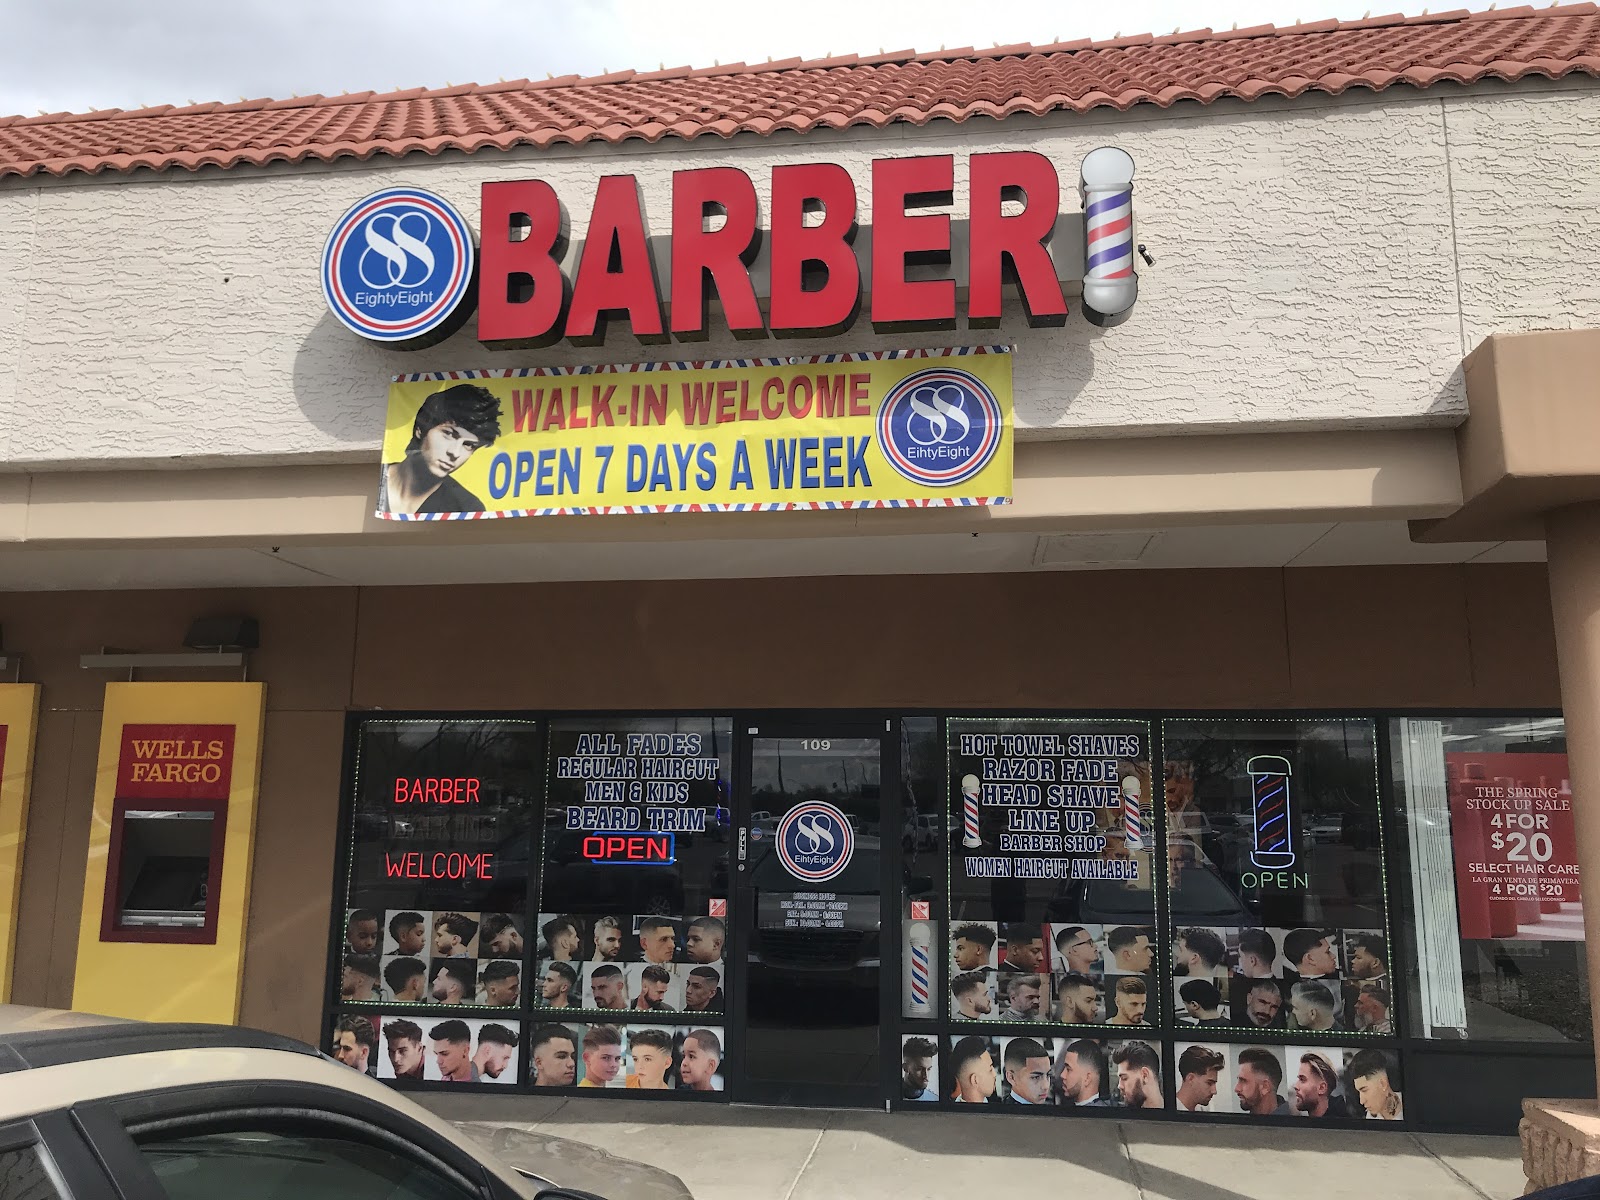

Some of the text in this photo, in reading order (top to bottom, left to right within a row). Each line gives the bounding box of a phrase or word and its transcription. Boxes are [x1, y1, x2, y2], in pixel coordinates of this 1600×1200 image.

[477, 150, 1068, 342] BARBER
[355, 290, 434, 310] EightyEight
[511, 373, 872, 433] WALK-IN WELCOME
[907, 445, 970, 461] EihtyEight
[488, 435, 873, 499] OPEN 7 DAYS A WEEK
[131, 739, 224, 760] WELLS
[576, 733, 702, 756] ALL FADES
[800, 739, 831, 750] 109
[960, 734, 1139, 757] HOT TOWEL SHAVES
[130, 763, 222, 783] FARGO
[557, 757, 719, 780] REGULAR HAIRCUT
[983, 758, 1118, 782] RAZOR FADE
[394, 777, 480, 803] BARBER
[585, 781, 689, 803] MEN & KIDS
[982, 784, 1120, 808] HEAD SHAVE
[1475, 786, 1559, 799] THE SPRING
[1466, 799, 1571, 811] STOCK UP SALE
[566, 806, 706, 831] BEARD TRIM
[1008, 810, 1096, 833] LINE UP
[1490, 813, 1550, 830] 4 FOR
[582, 837, 668, 859] OPEN
[1000, 834, 1106, 852] BARBER SHOP
[1490, 830, 1553, 862] $20
[385, 852, 494, 879] WELCOME
[794, 855, 834, 865] EihtyEight
[965, 857, 1138, 880] WOMEN HAIRCUT AVAILABLE
[1468, 863, 1580, 875] SELECT HAIR CARE
[1241, 872, 1309, 889] OPEN
[1483, 876, 1503, 884] GRAN
[1539, 877, 1580, 885] PRIMAVERA
[1492, 883, 1563, 896] 4 POR $20
